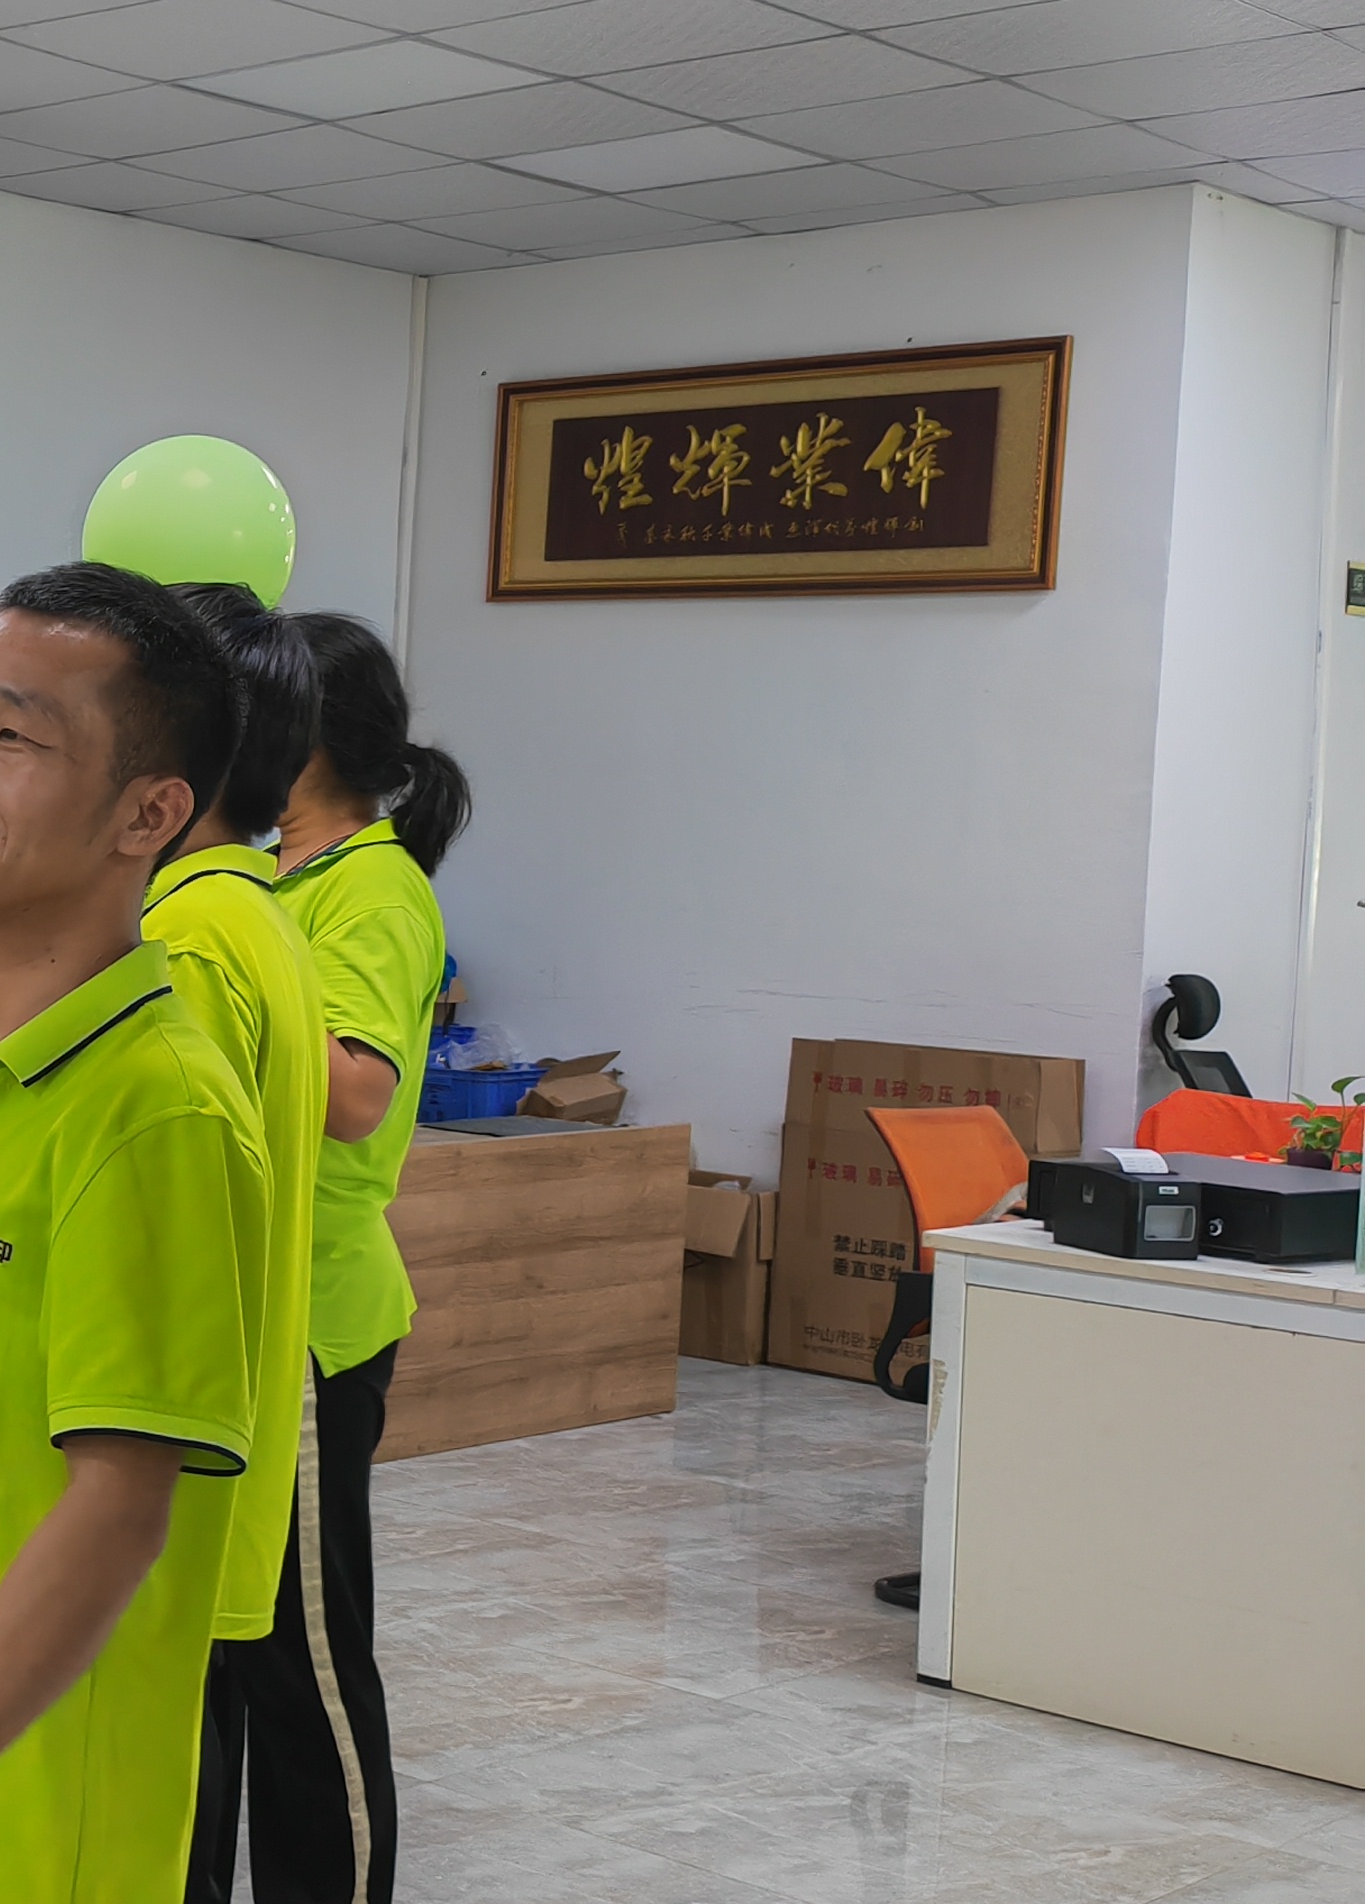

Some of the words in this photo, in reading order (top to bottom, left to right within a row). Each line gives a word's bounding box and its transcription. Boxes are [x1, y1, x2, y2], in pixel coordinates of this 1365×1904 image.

[828, 1075, 864, 1096] 玻璃
[873, 1078, 909, 1100] 易碎
[918, 1084, 954, 1104] 勿压
[822, 1161, 858, 1184] 玻璃
[833, 1234, 907, 1261] 禁止踩踏
